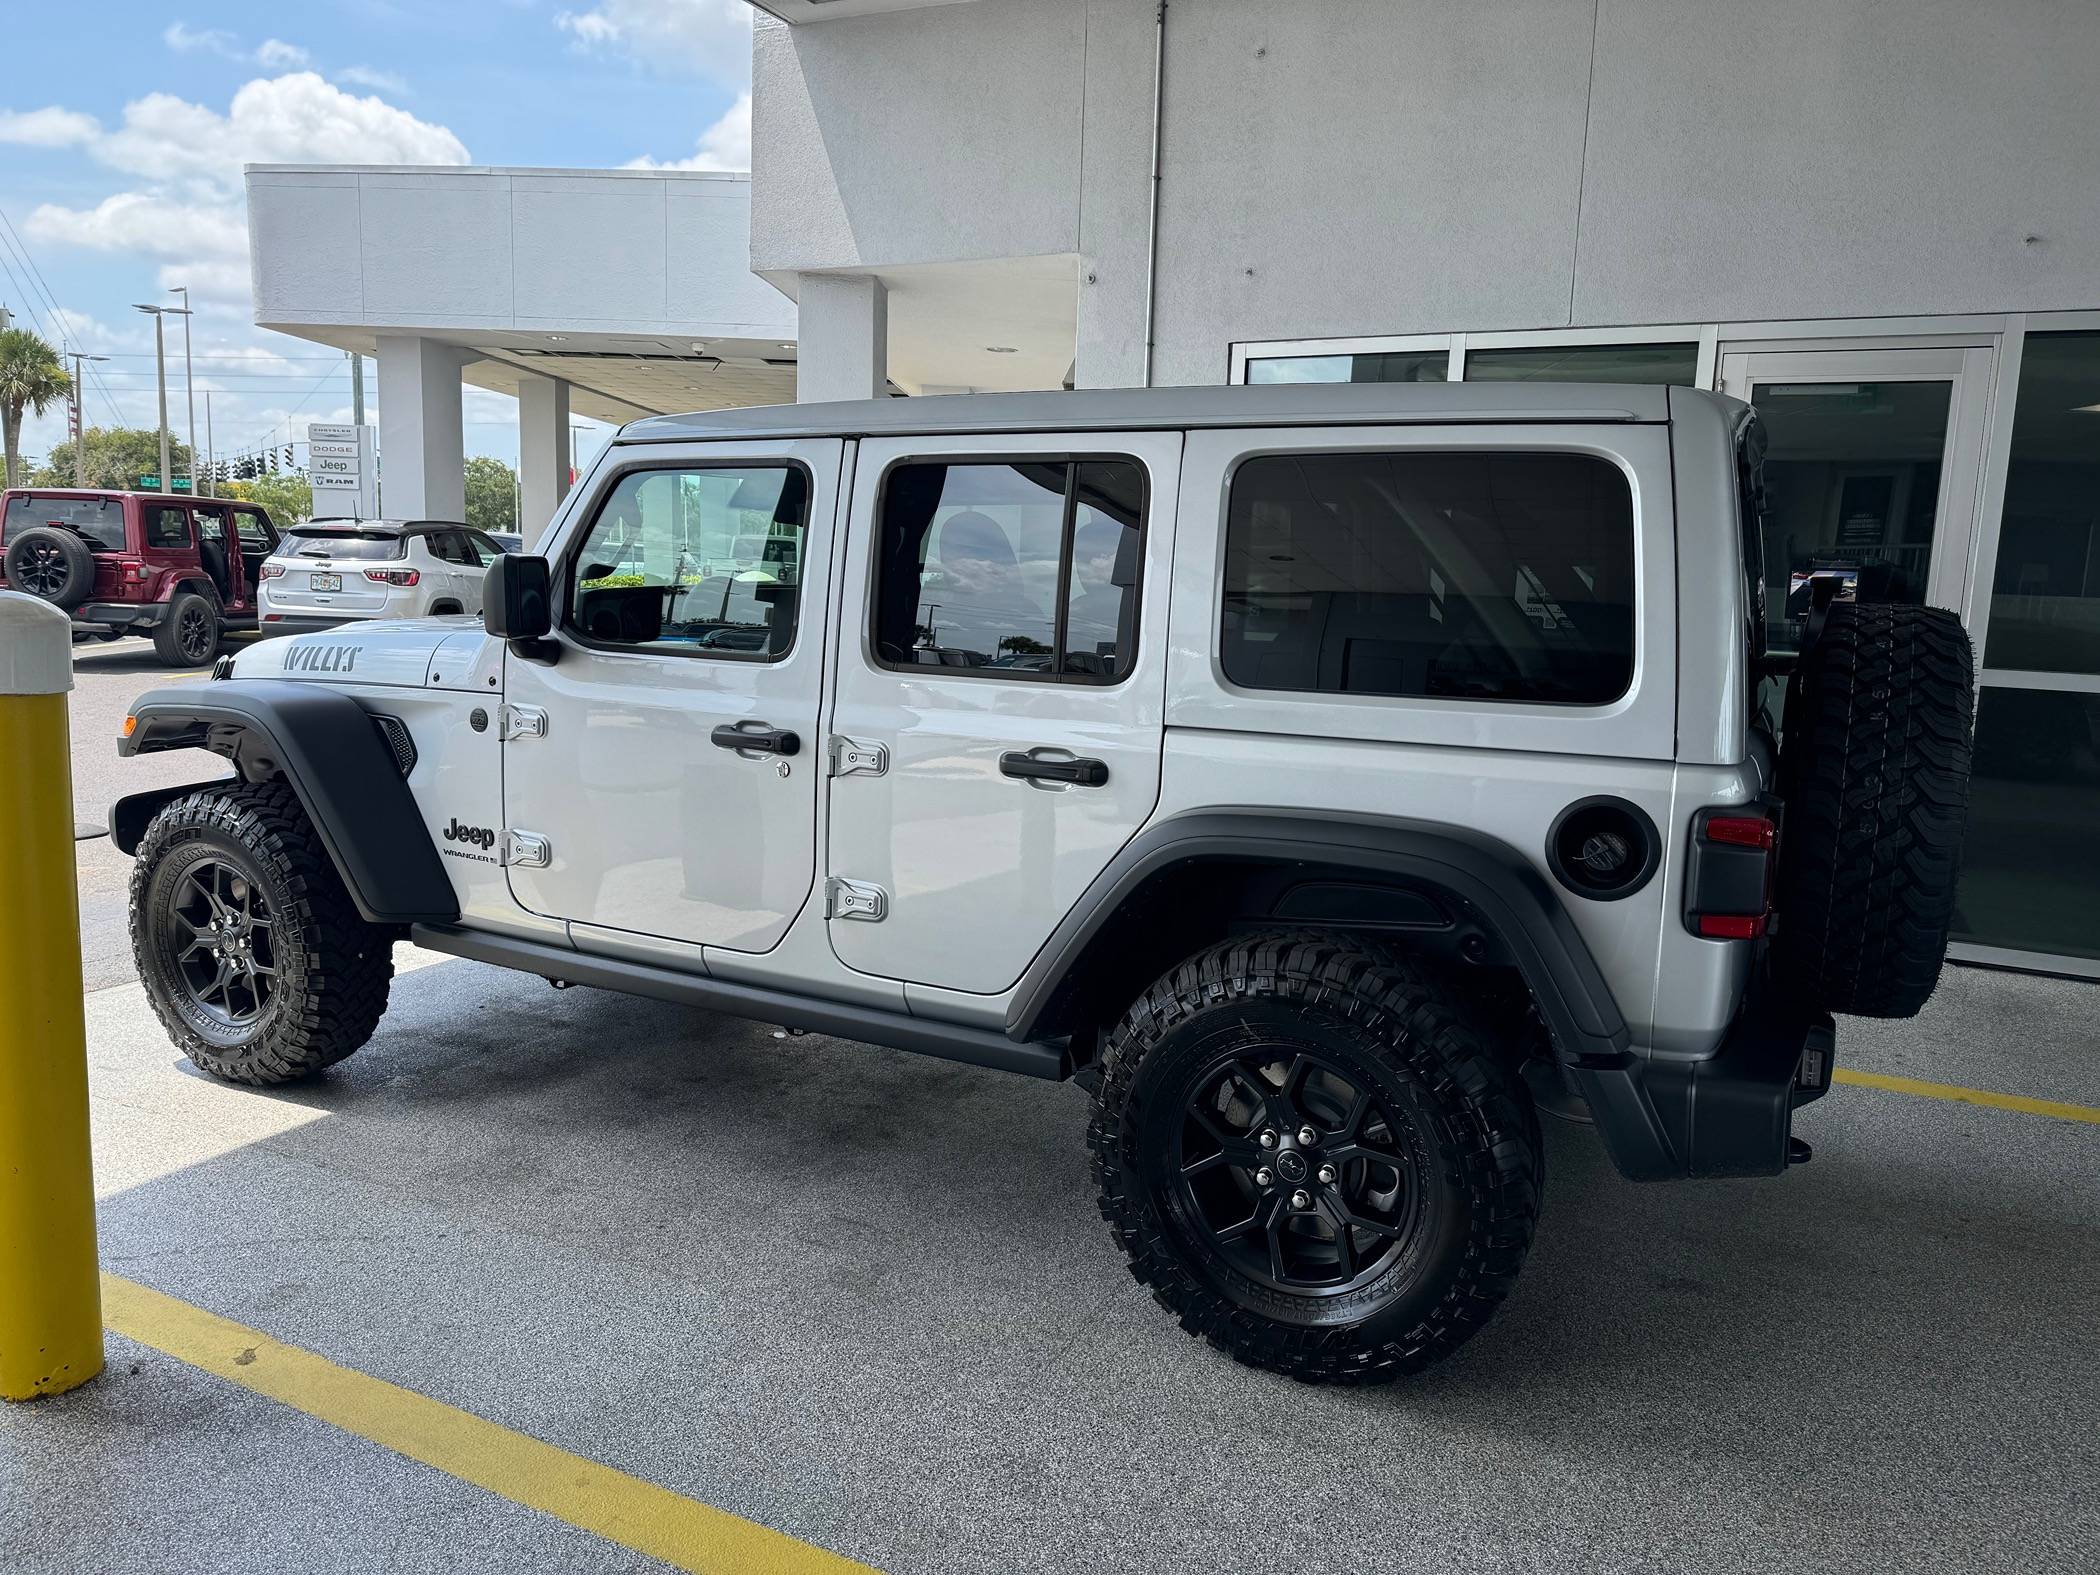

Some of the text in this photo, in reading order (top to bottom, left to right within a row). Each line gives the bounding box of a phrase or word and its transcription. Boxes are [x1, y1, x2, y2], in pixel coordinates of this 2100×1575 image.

[320, 460, 347, 471] Jeep
[284, 646, 363, 672] WILLYS
[443, 818, 495, 851] Jeep
[443, 849, 489, 862] WRANGLER
